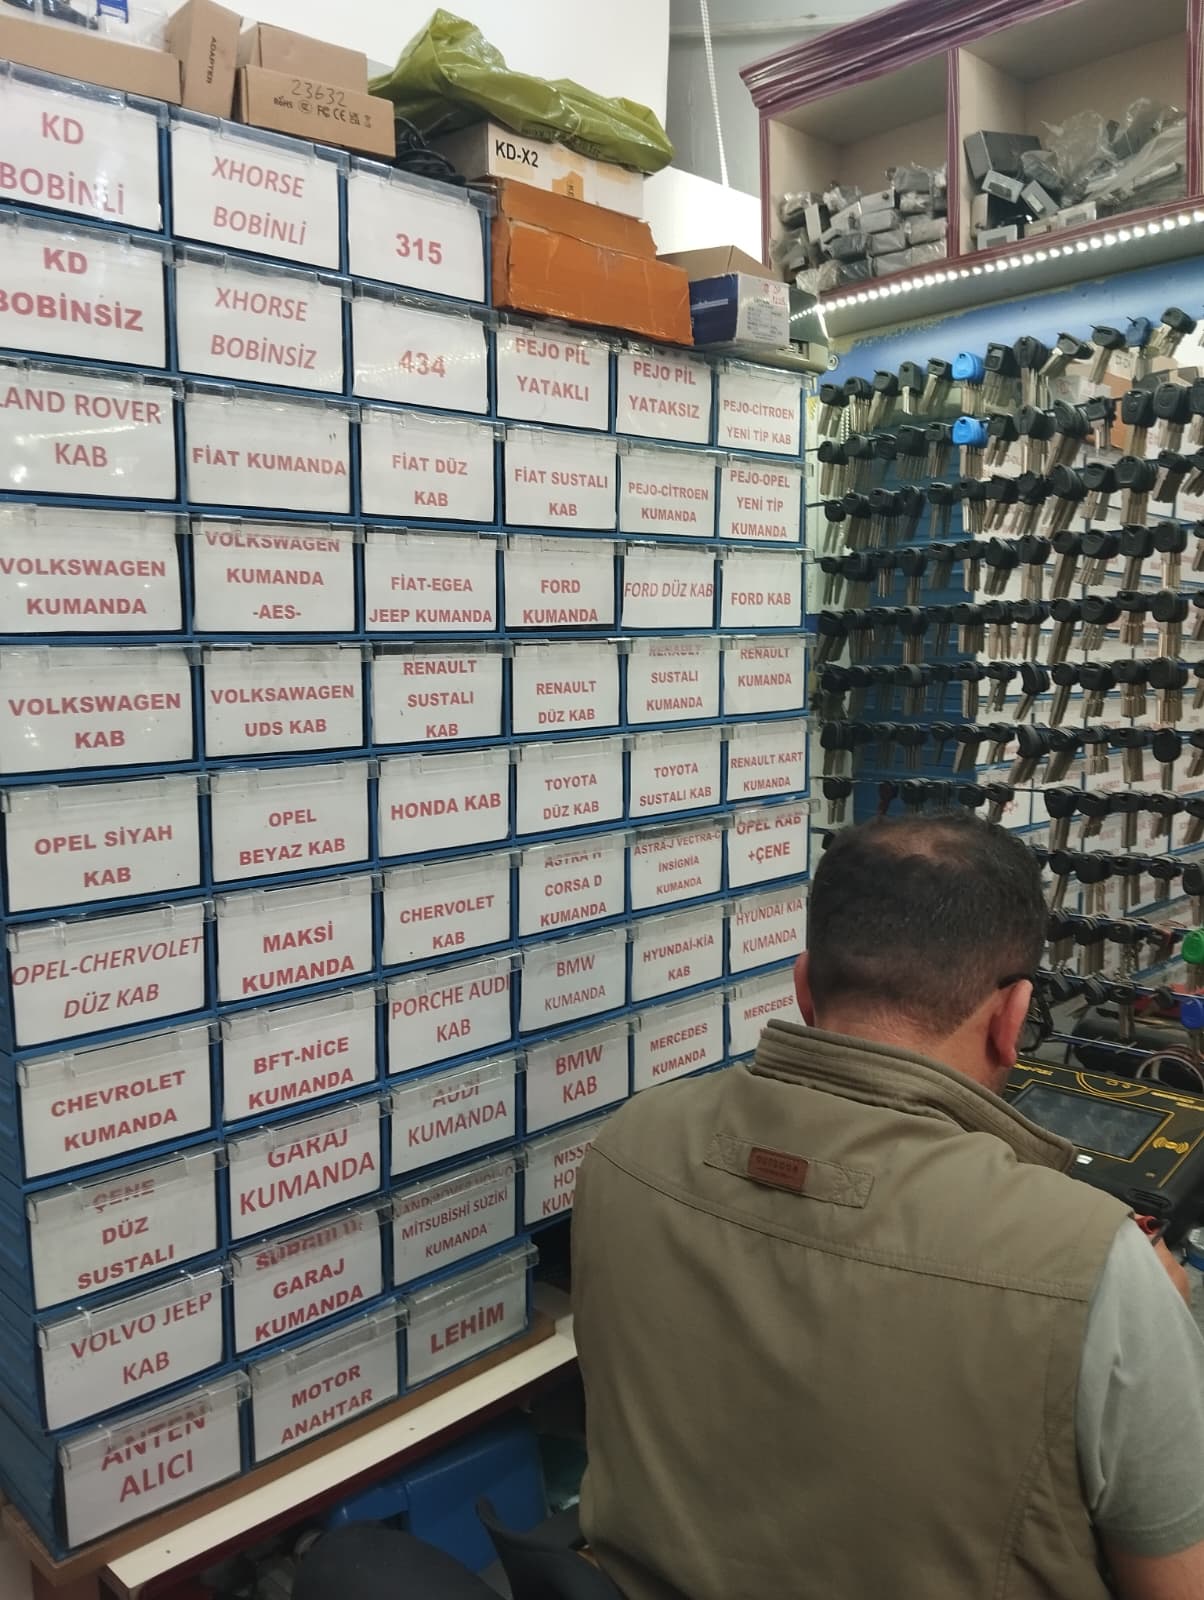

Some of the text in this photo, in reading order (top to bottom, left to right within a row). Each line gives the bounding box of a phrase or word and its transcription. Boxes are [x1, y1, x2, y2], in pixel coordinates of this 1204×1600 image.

[291, 79, 347, 108] 23632
[42, 112, 84, 144] KD
[495, 139, 539, 168] KD-X2
[212, 159, 303, 198] XHORSE
[213, 206, 306, 244] BOBİNLİ
[43, 247, 87, 274] KD
[396, 233, 442, 265] 315
[216, 288, 306, 321] XHORSE
[211, 335, 317, 369] BOBİNSİZ
[515, 337, 560, 359] PEJO
[399, 350, 446, 378] 434
[633, 359, 696, 384] PEJO PİL
[517, 376, 589, 401] YATAKLI
[0, 387, 160, 424] AND ROVER
[629, 395, 699, 419] YATAKSIZ
[722, 400, 794, 419] PEJO-CİTROEN
[772, 433, 791, 445] KAB
[55, 442, 107, 467] KAB
[192, 446, 346, 476] FİAT KUMANDA
[392, 454, 467, 475] FİAT DÜZ
[515, 467, 608, 488] FİAT SUSTALI
[730, 470, 788, 488] PEJO-OPEL
[415, 490, 448, 506] KAB
[629, 482, 708, 500] PEJO-CİTROEN
[549, 502, 577, 516] KAB
[641, 507, 696, 522] KUMANDA
[205, 531, 341, 552] VOLKSWAGEN
[732, 522, 787, 537] KUMANDA
[0, 558, 165, 576] VOLKSWAGEN
[227, 568, 324, 585] KUMANDA
[391, 576, 472, 591] FİAT-EGEA
[541, 579, 580, 593] FORD
[624, 580, 715, 597] FORD DÜZ KAB
[27, 598, 147, 615] KUMANDA
[731, 592, 791, 605] FORD KAB
[253, 604, 302, 620] -AES-
[369, 609, 492, 622] JEEP KUMANDA
[523, 609, 598, 623] KUMANDA
[740, 647, 791, 660] RENAULT
[403, 660, 476, 675] RENAULT
[651, 671, 698, 683] SUSTALI
[536, 681, 596, 695] RENAULT
[738, 673, 792, 687] KUMANDA
[8, 693, 181, 716] VOLKSWAGEN
[211, 685, 354, 704] VOLKSAWAGEN
[408, 691, 473, 707] SUSTALI
[647, 696, 703, 711] KUMANDA
[245, 719, 327, 737] UDS KAB
[538, 708, 595, 724] DÜZ KAB
[75, 730, 125, 749] KAB
[426, 724, 458, 737] KAB
[654, 763, 698, 777] TOYOTA
[731, 752, 803, 768] RENAULT KART
[545, 774, 597, 791] TOYOTA
[744, 776, 791, 791] KUMANDA
[391, 793, 501, 820] HONDA KAB
[640, 786, 711, 807] SUSTALI KAB
[269, 809, 317, 827] OPEL
[544, 801, 599, 820] DÜZ KAB
[35, 825, 172, 855] OPEL SİYAH
[240, 838, 345, 865] BEYAZ KAB
[84, 867, 131, 887] KAB
[545, 875, 602, 896] CORSA D
[656, 876, 702, 895] KUMANDA
[400, 895, 495, 924] CHERVOLET
[541, 902, 606, 927] KUMANDA
[263, 921, 333, 953] MAKSİ
[433, 931, 465, 949] KAB
[743, 928, 797, 954] KUMANDA
[12, 936, 203, 985] OPEL-CHERVOLET
[556, 956, 595, 977] BMW
[243, 956, 354, 994] KUMANDA
[668, 965, 690, 981] KAB
[64, 984, 159, 1019] DÜZ KAB
[392, 986, 463, 1019] PORCHE
[545, 985, 605, 1010] KUMANDA
[744, 995, 794, 1020] MERCEDES
[437, 1019, 471, 1042] KAB
[650, 1023, 708, 1051] MERCEDES
[254, 1037, 349, 1075] BFT-NİCE
[555, 1046, 602, 1075] BMW
[653, 1048, 705, 1076] KUMANDA
[51, 1070, 186, 1118] CHEVROLET
[249, 1068, 353, 1113] KUMANDA
[563, 1076, 597, 1103] KAB
[65, 1109, 177, 1151] KUMANDA
[409, 1097, 507, 1147] KUMANDA
[267, 1128, 348, 1168] GARAJ
[241, 1152, 375, 1216] KUMANDA
[102, 1216, 149, 1245] DÜZ
[425, 1219, 487, 1257] KUMANDA
[78, 1245, 173, 1289] SUSTALI
[273, 1258, 344, 1299] GARAJ
[70, 1291, 212, 1358] VOLVO JEEP
[256, 1285, 364, 1341] KUMANDA
[431, 1302, 505, 1354] LEHİM
[123, 1352, 169, 1384] KAB
[292, 1365, 360, 1408] MOTOR
[282, 1384, 373, 1444] ANAHTAR
[120, 1447, 193, 1503] ALICI
